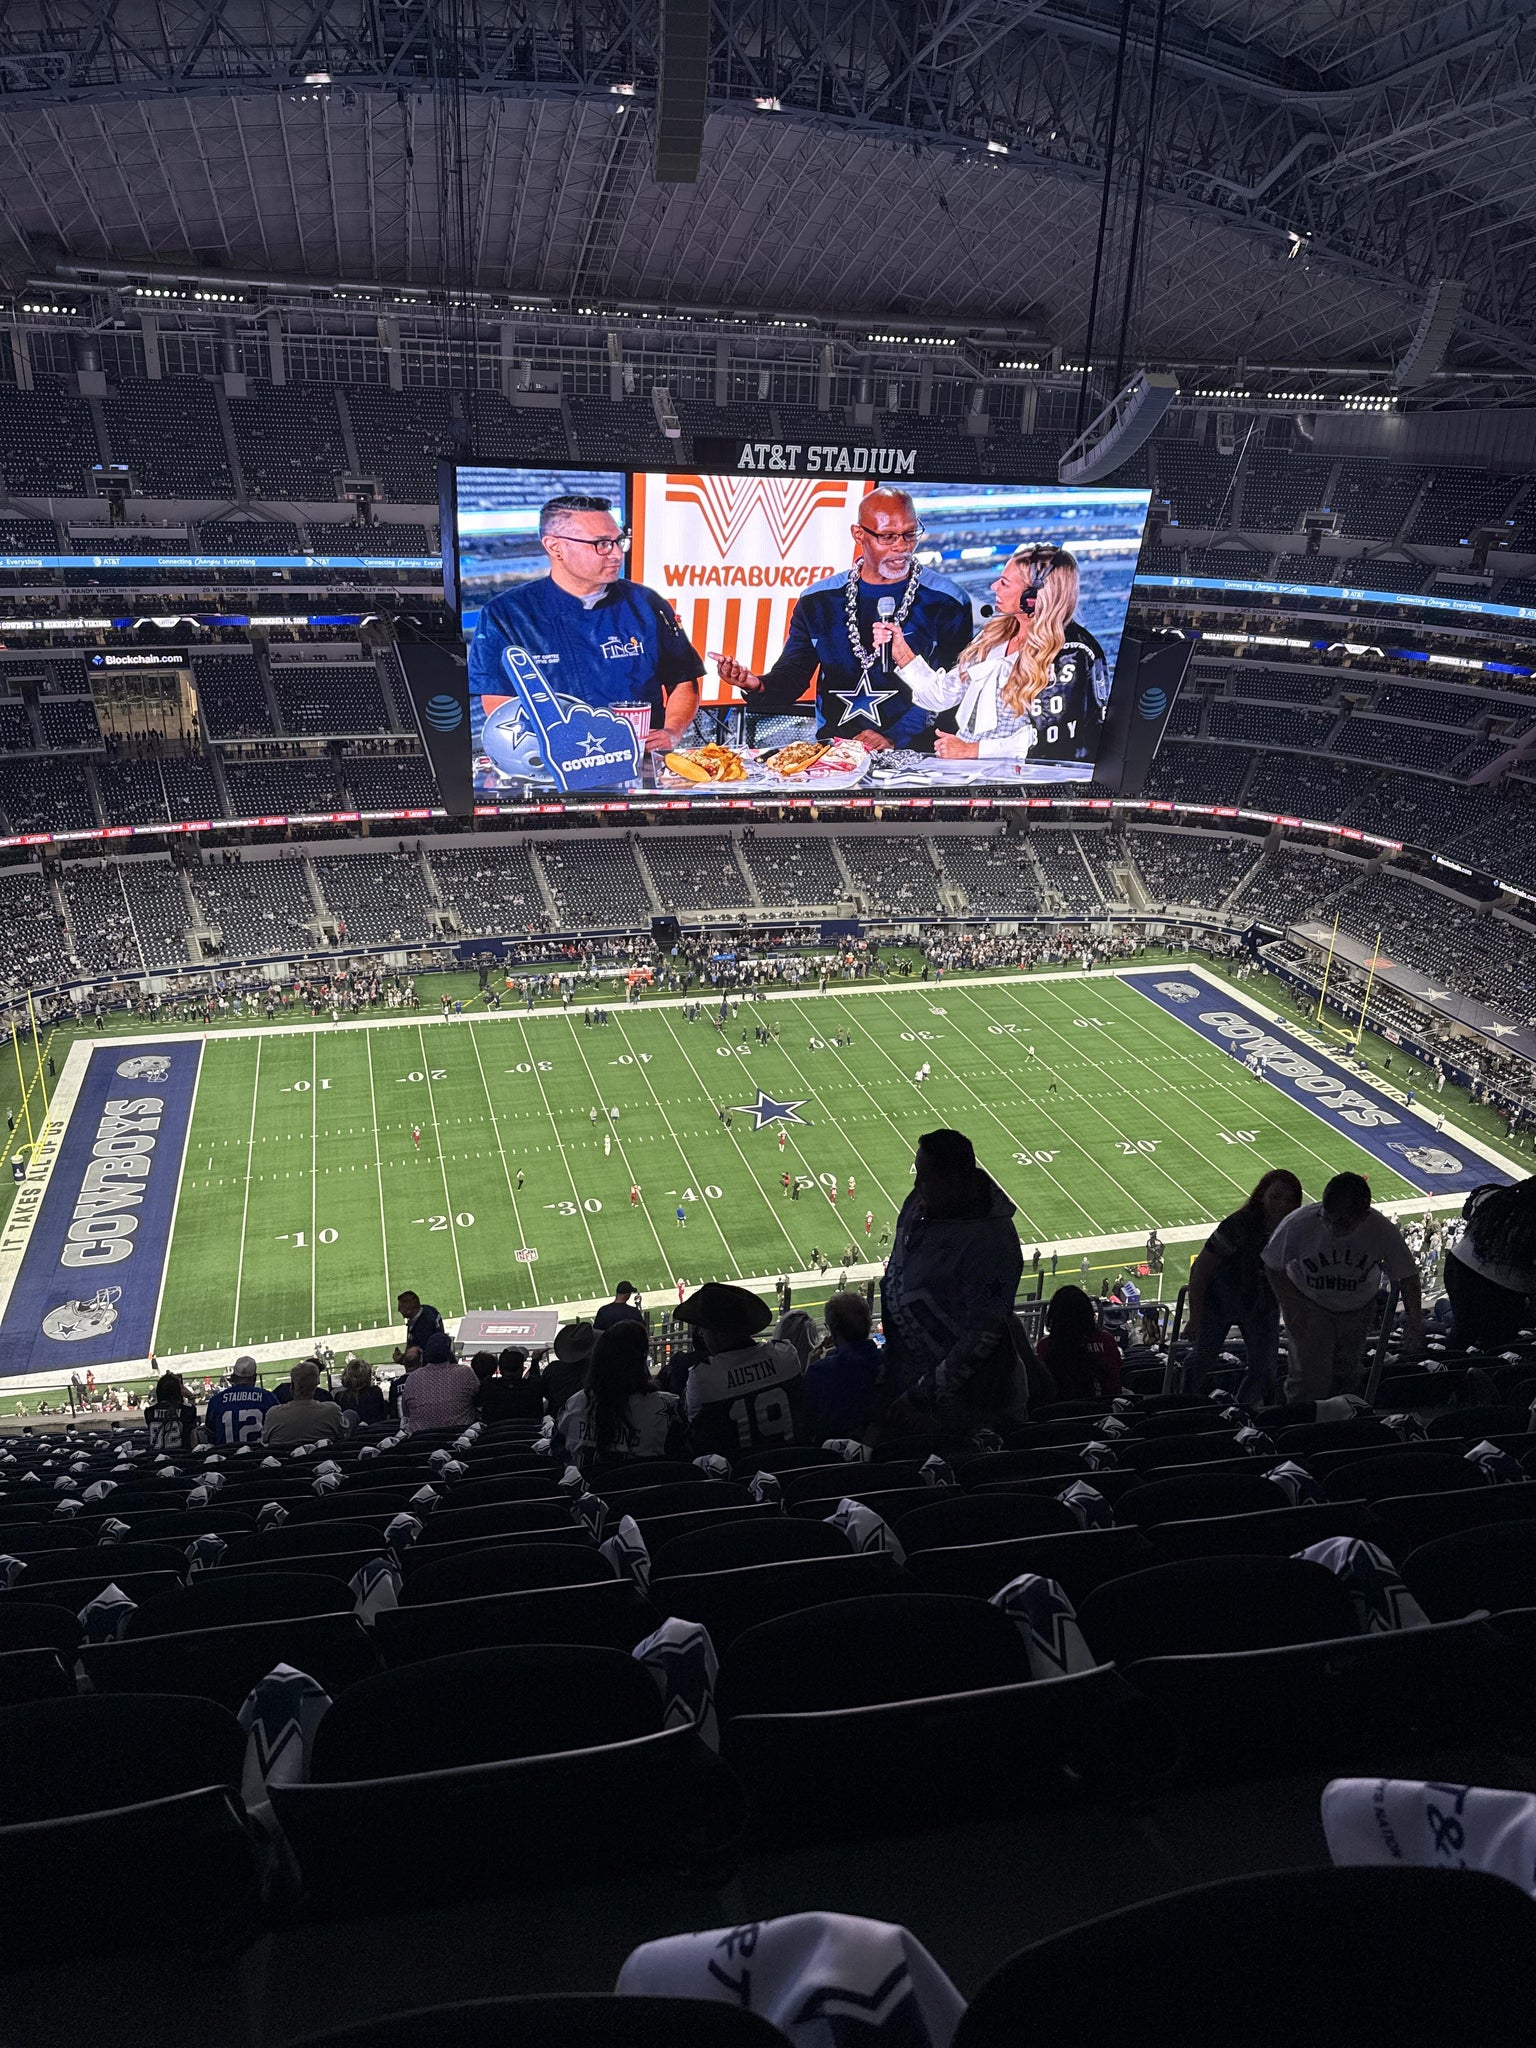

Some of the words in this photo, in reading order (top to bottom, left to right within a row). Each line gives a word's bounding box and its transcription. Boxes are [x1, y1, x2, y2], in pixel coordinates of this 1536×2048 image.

[737, 443, 802, 471] AT&T
[806, 446, 917, 474] STADIUM
[158, 558, 192, 566] Connecting
[223, 558, 256, 566] Everything
[1396, 595, 1426, 604] Connecting
[1453, 602, 1483, 611] Everything
[599, 641, 645, 659] FINCH
[105, 654, 183, 665] Blockchain.com
[561, 749, 633, 772] COWBOYS
[1499, 881, 1536, 902] Blockchain.co
[987, 1023, 1022, 1035] 20
[618, 1053, 653, 1065] 40
[716, 1045, 752, 1057] 50
[516, 1060, 553, 1073] 30
[1198, 1011, 1402, 1127] COWBOYS
[293, 1078, 333, 1092] 10
[407, 1069, 448, 1083] 20
[1347, 1062, 1406, 1104] SERVIC
[46, 1120, 65, 1138] US
[1215, 1130, 1256, 1145] 10
[41, 1137, 58, 1155] OF
[1114, 1140, 1156, 1155] 20
[1011, 1150, 1053, 1166] 30
[27, 1158, 53, 1182] ALL
[60, 1097, 164, 1267] COWBOYS
[794, 1172, 838, 1190] 50
[681, 1185, 724, 1202] 40
[9, 1187, 42, 1232] TAKES
[557, 1198, 603, 1216] 30
[427, 1212, 476, 1232] 20
[1, 1239, 25, 1252] IT
[291, 1228, 339, 1248] 10
[485, 1325, 531, 1334] ESPN
[727, 1358, 777, 1389] AUSTIN
[222, 1391, 263, 1404] STAUBACH
[222, 1408, 264, 1444] 12
[728, 1386, 794, 1448] 19
